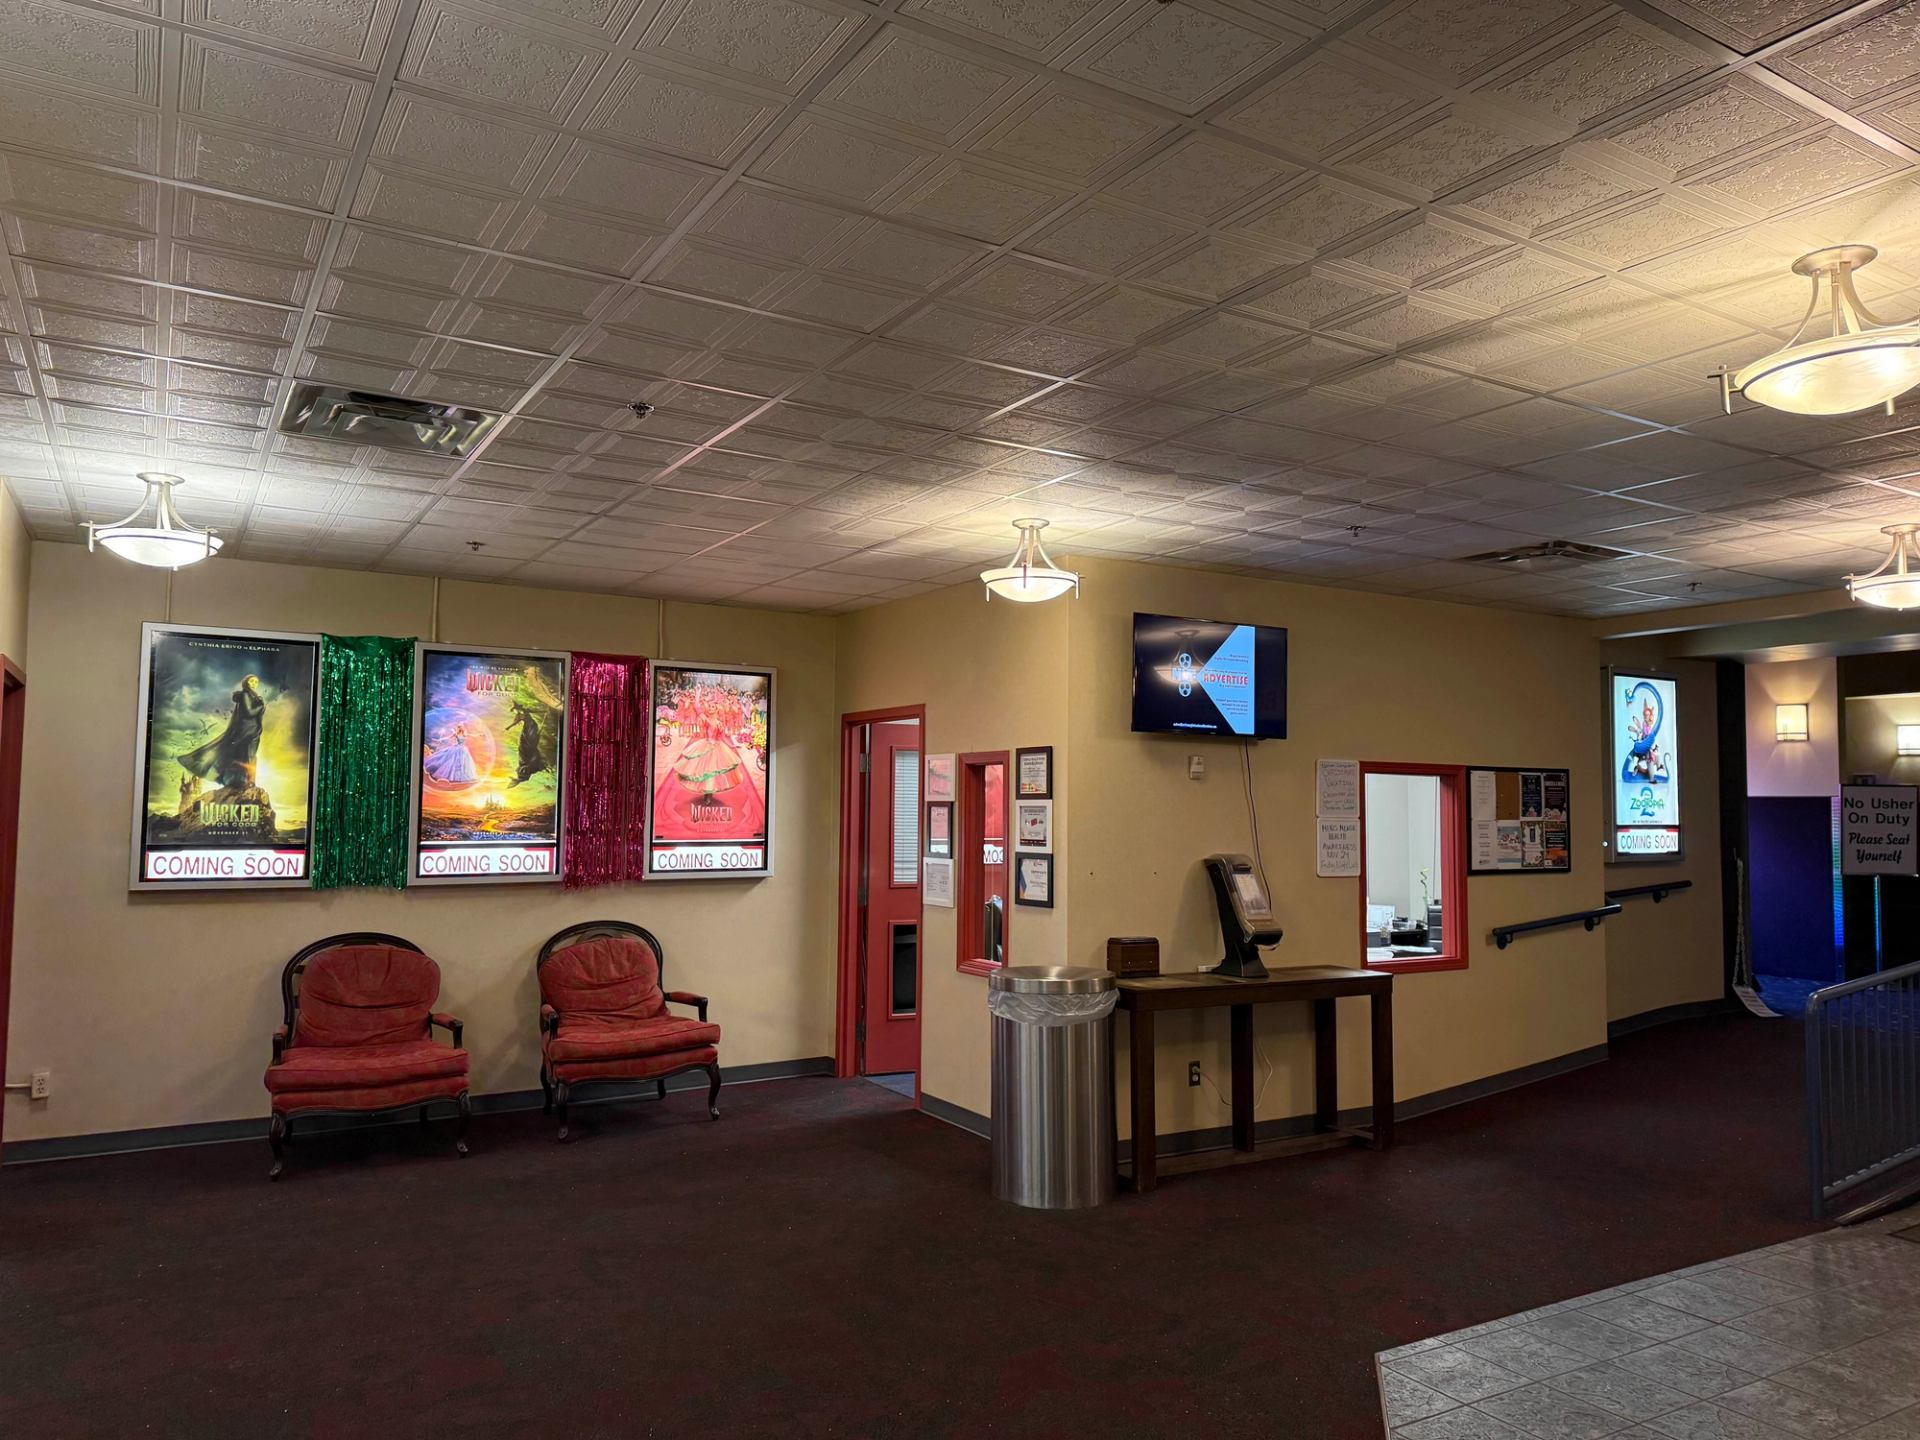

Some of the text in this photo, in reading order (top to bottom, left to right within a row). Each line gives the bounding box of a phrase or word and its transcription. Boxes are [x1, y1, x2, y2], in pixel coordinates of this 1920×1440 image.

[188, 641, 220, 649] CYNTHIA
[465, 667, 521, 693] WICKED
[1203, 673, 1249, 686] ADVERTISE
[200, 799, 260, 824] WICKED
[1844, 797, 1915, 810] No Usher
[690, 803, 733, 823] WICKED
[1848, 812, 1910, 827] On Duty
[1620, 834, 1677, 850] COMING SOON
[1849, 832, 1910, 845] Please Seat
[422, 854, 546, 873] COMING SOON
[658, 852, 759, 869] COMING SOON
[1856, 849, 1902, 864] Yourself
[153, 856, 300, 876] COMING SOON
